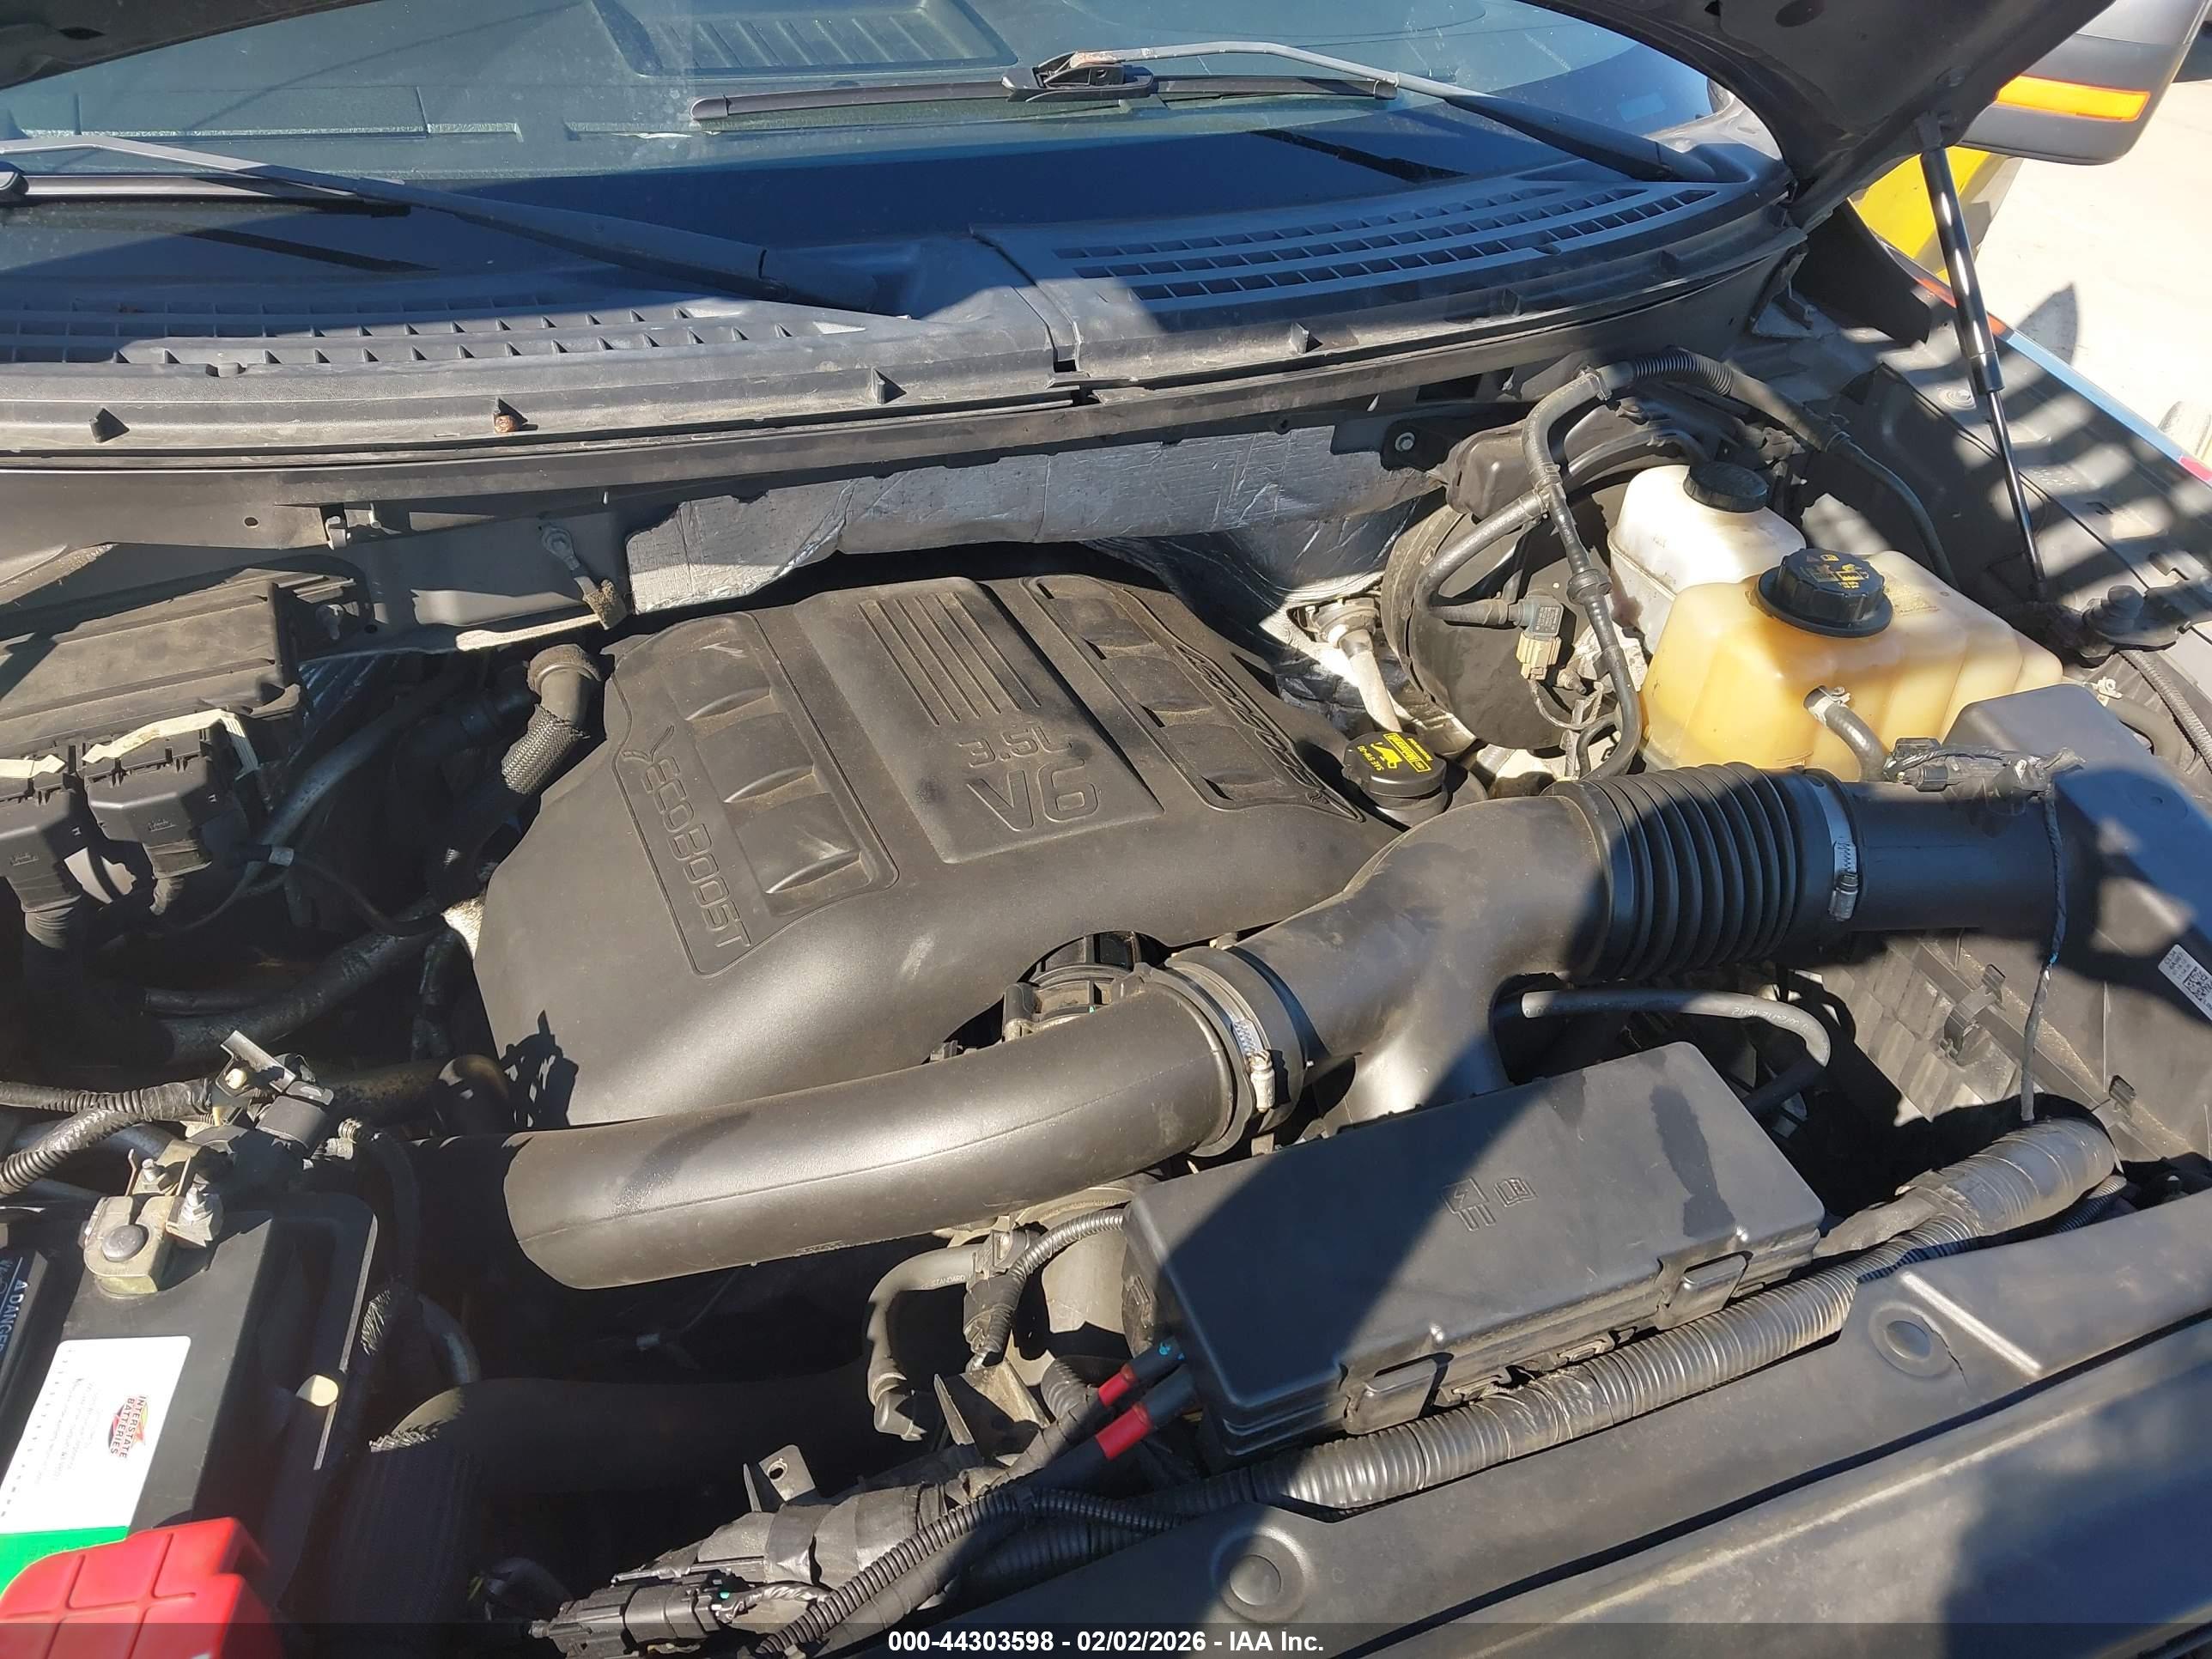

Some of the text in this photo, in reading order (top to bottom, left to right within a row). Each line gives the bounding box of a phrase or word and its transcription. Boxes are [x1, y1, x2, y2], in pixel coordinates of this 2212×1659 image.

[957, 726, 1073, 769] 3.5L
[966, 757, 1099, 832] V6
[641, 755, 752, 948] ECOBOOST
[110, 1398, 135, 1454] BATTERIES
[119, 1395, 147, 1458] INTERSTATE
